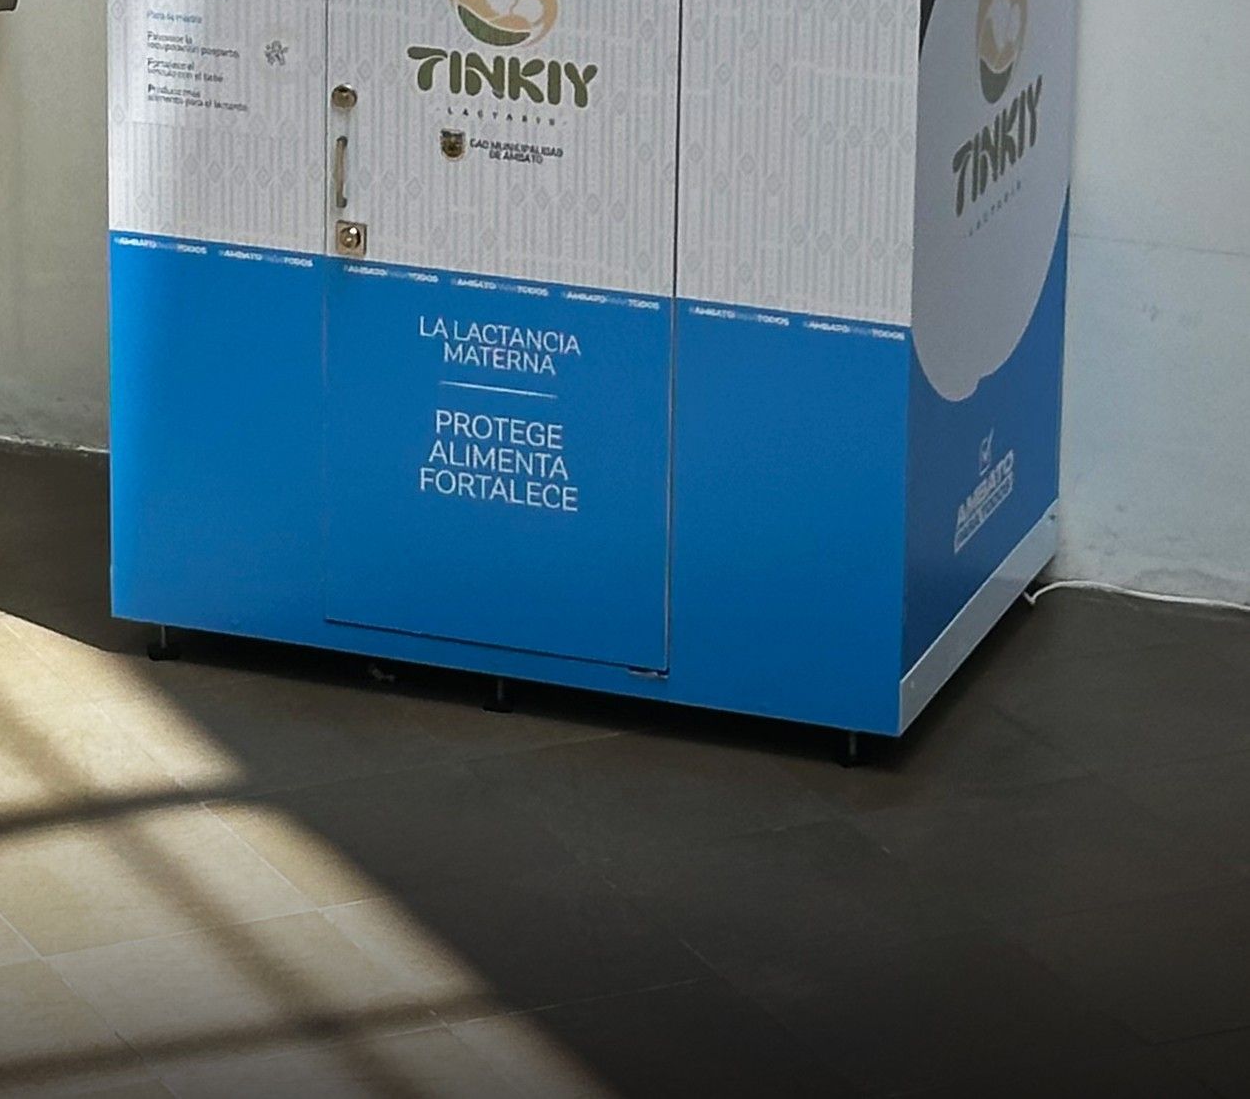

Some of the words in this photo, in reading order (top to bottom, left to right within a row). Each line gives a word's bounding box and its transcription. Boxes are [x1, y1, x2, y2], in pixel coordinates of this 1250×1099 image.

[406, 45, 598, 108] TINKIY
[419, 315, 448, 339] LA
[453, 319, 582, 356] LACTANCIA
[443, 341, 557, 376] MATERNA
[436, 409, 564, 450] PROTEGE
[428, 439, 569, 481] ALIMENTA
[420, 467, 579, 512] FORTALECE
